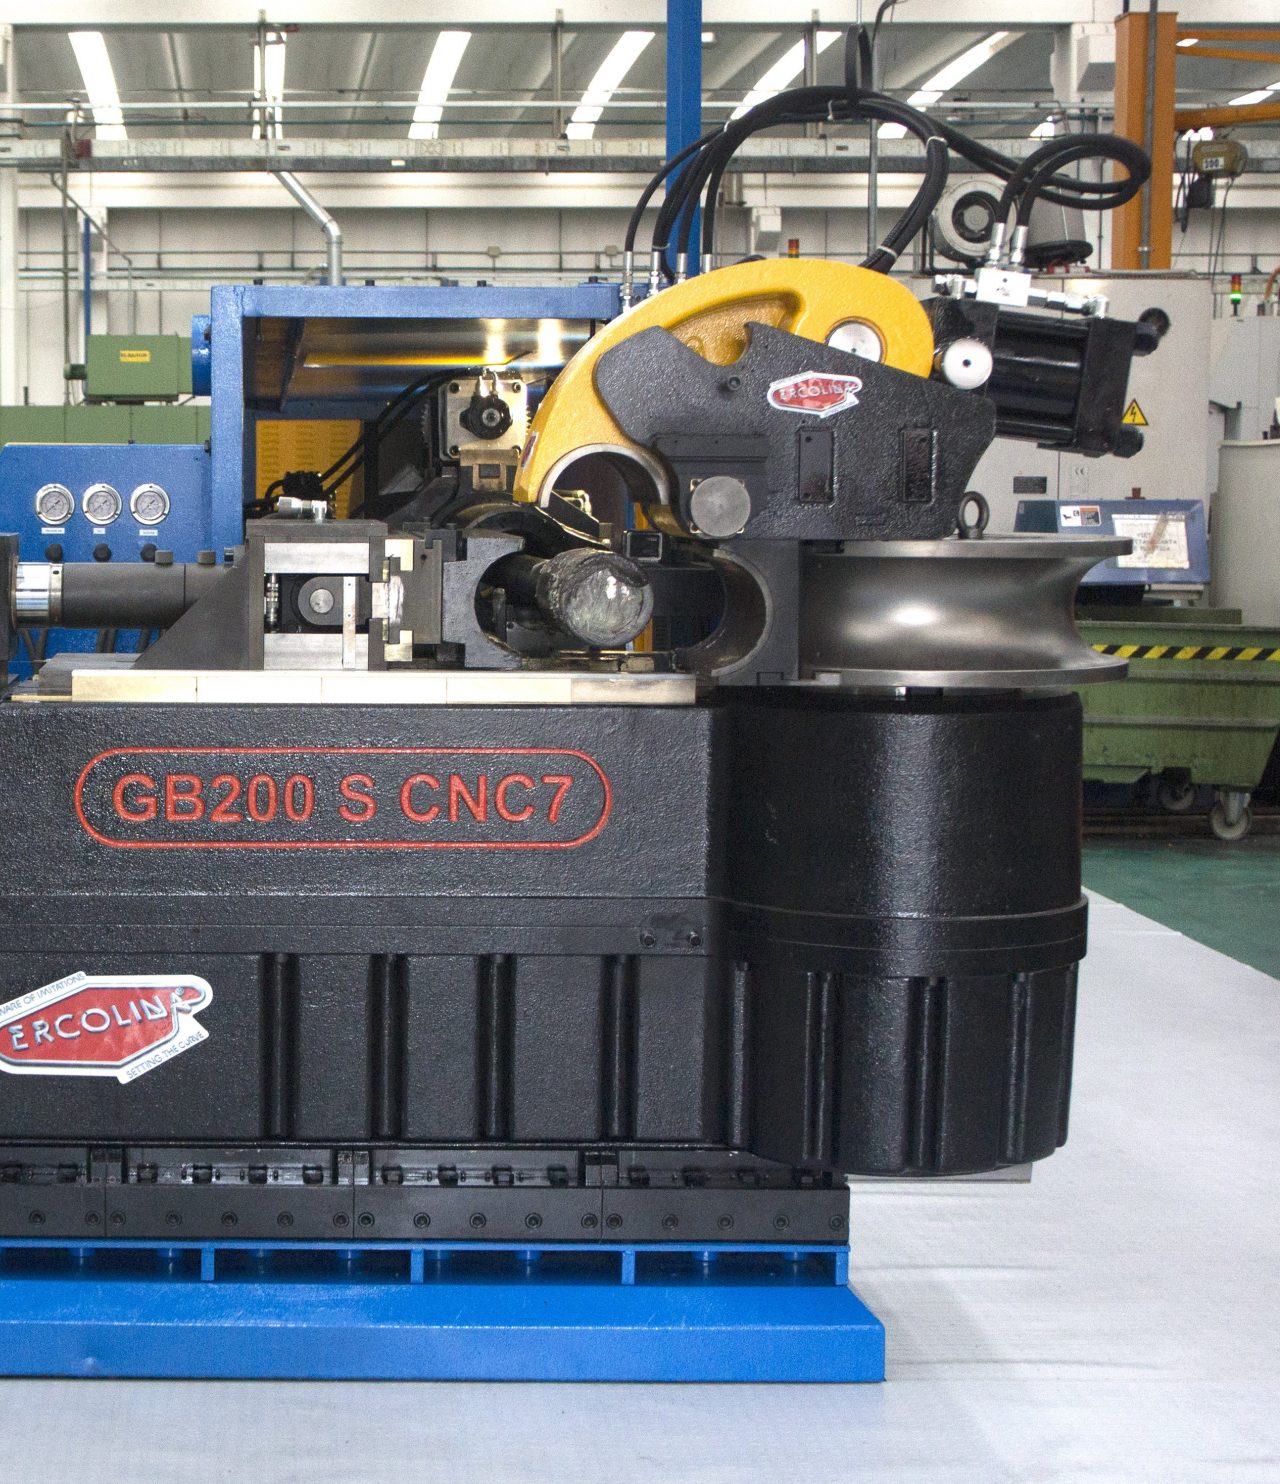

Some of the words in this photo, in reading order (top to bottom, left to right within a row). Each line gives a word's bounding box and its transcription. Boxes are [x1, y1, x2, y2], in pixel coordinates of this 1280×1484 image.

[112, 773, 315, 823] GB200
[338, 773, 377, 823] S
[400, 773, 576, 823] CNC7
[23, 993, 36, 1004] OF
[37, 973, 85, 999] IMITATIONS
[126, 1054, 163, 1079] SETTING
[161, 1045, 179, 1057] THE
[178, 1031, 204, 1049] CURVE
